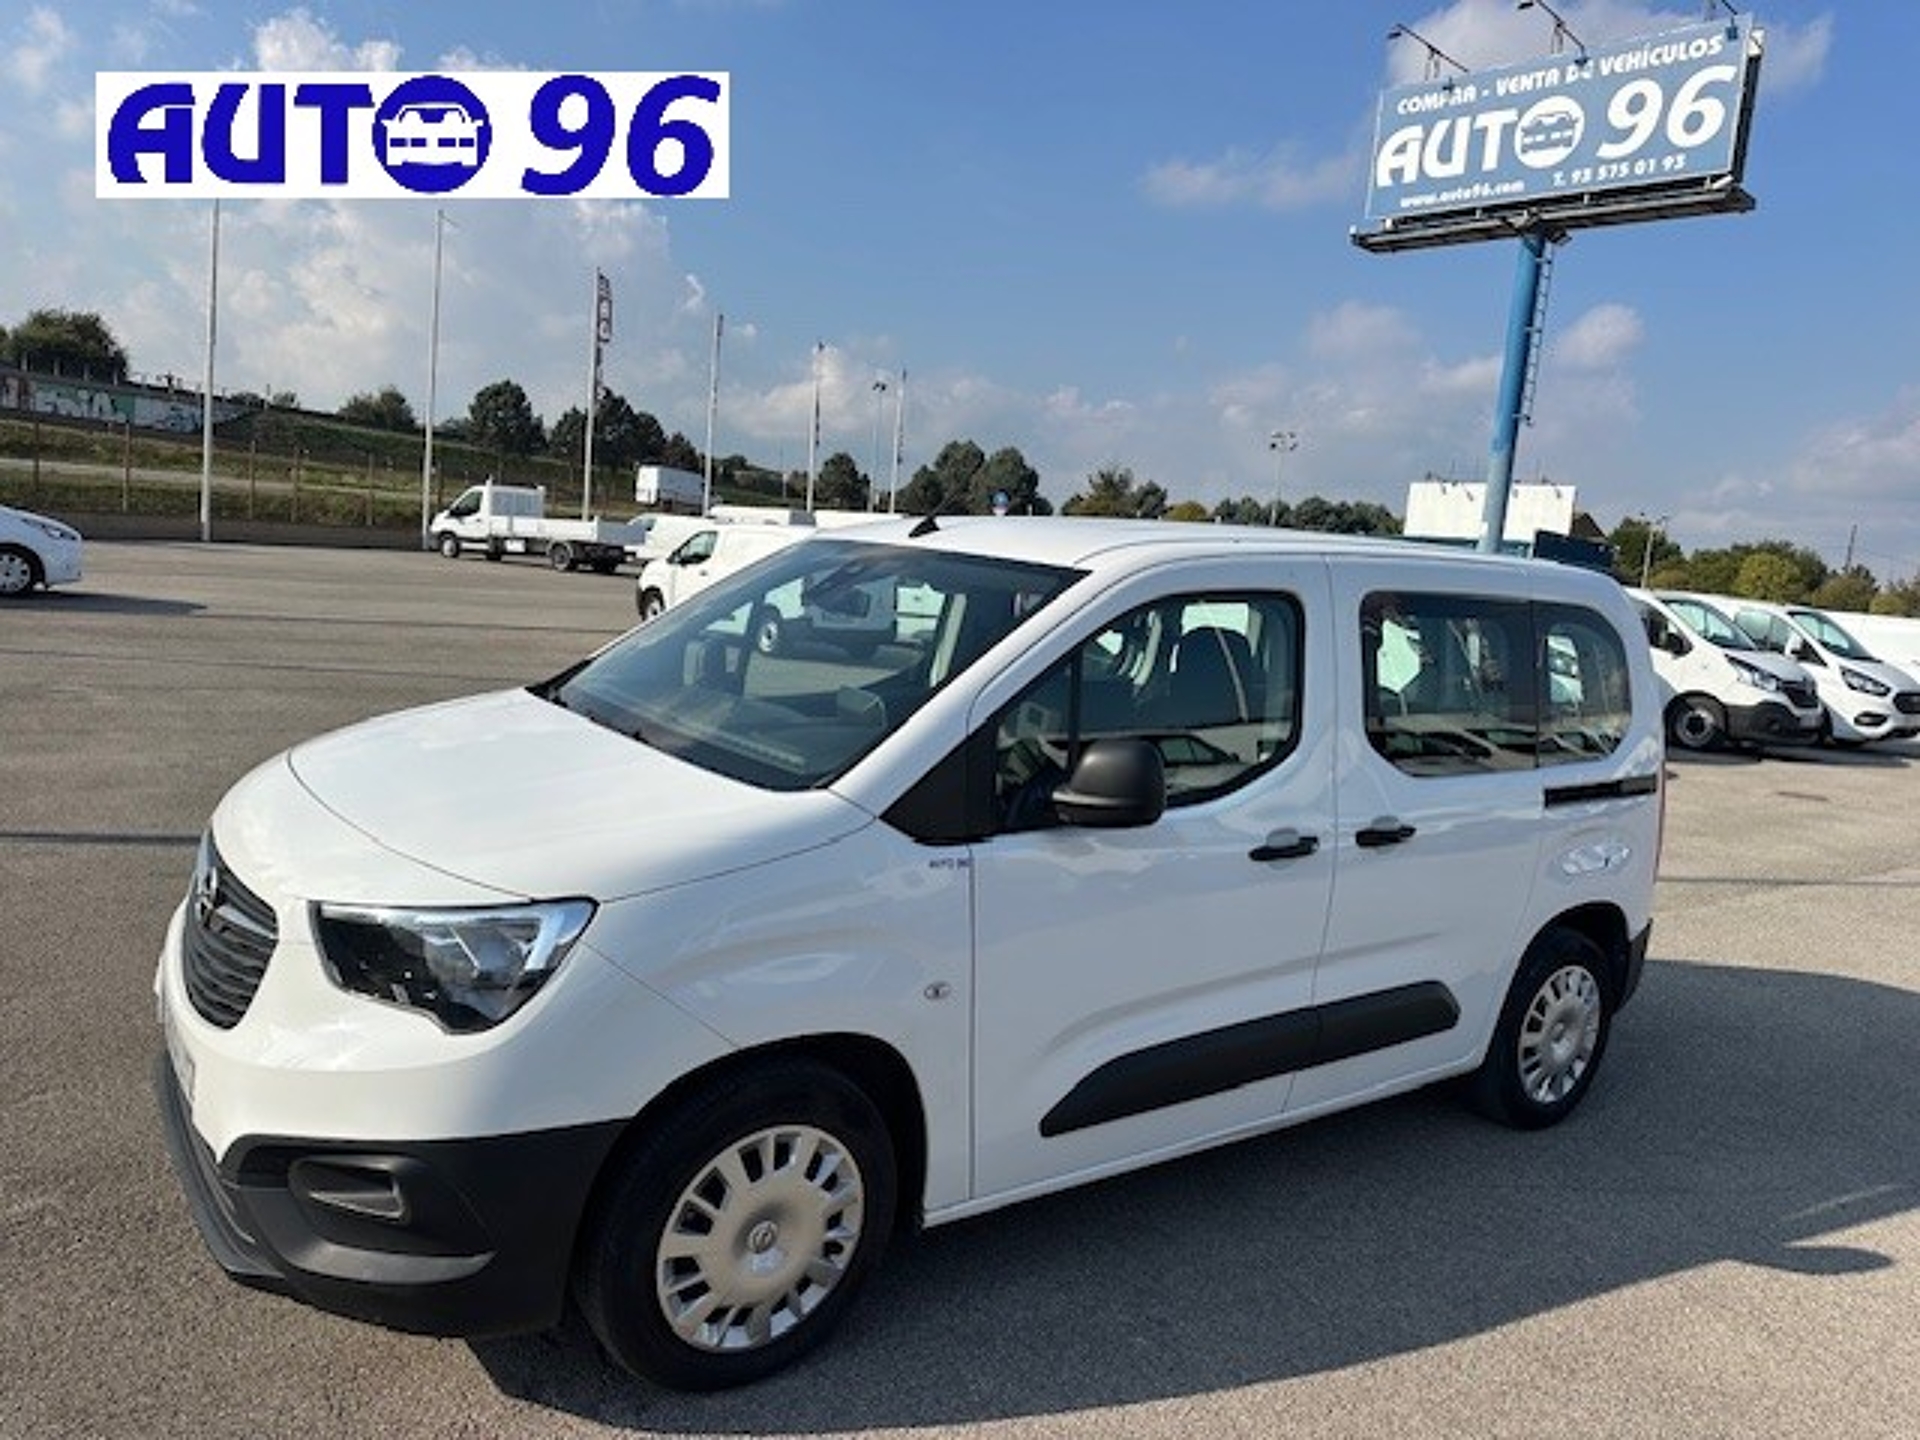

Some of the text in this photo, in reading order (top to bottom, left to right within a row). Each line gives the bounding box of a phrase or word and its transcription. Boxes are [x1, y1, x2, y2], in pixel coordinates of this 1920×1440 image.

[1496, 67, 1560, 96] VENTA
[1601, 35, 1723, 76] VEHÍCULOS
[1376, 65, 1738, 188] AUTO 96
[1598, 161, 1630, 181] 575
[1634, 158, 1656, 175] 01
[1401, 180, 1525, 208] www.auto96.com
